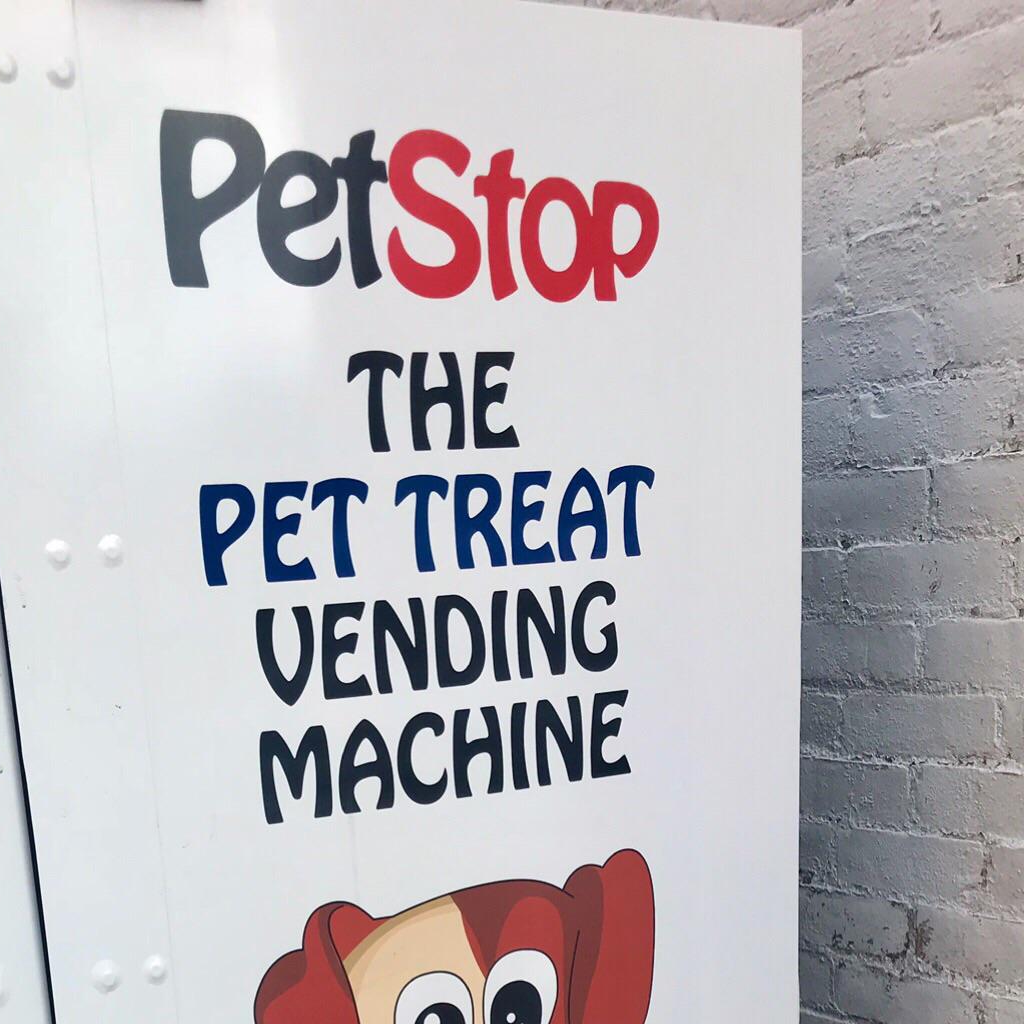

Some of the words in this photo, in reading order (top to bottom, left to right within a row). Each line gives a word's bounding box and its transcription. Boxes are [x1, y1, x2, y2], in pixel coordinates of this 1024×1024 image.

[158, 108, 660, 303] PetStop
[346, 350, 520, 453] THE
[198, 477, 369, 587] PET
[395, 464, 656, 573] TREAT
[255, 580, 619, 707] VENDING
[259, 690, 632, 825] MACHINE
